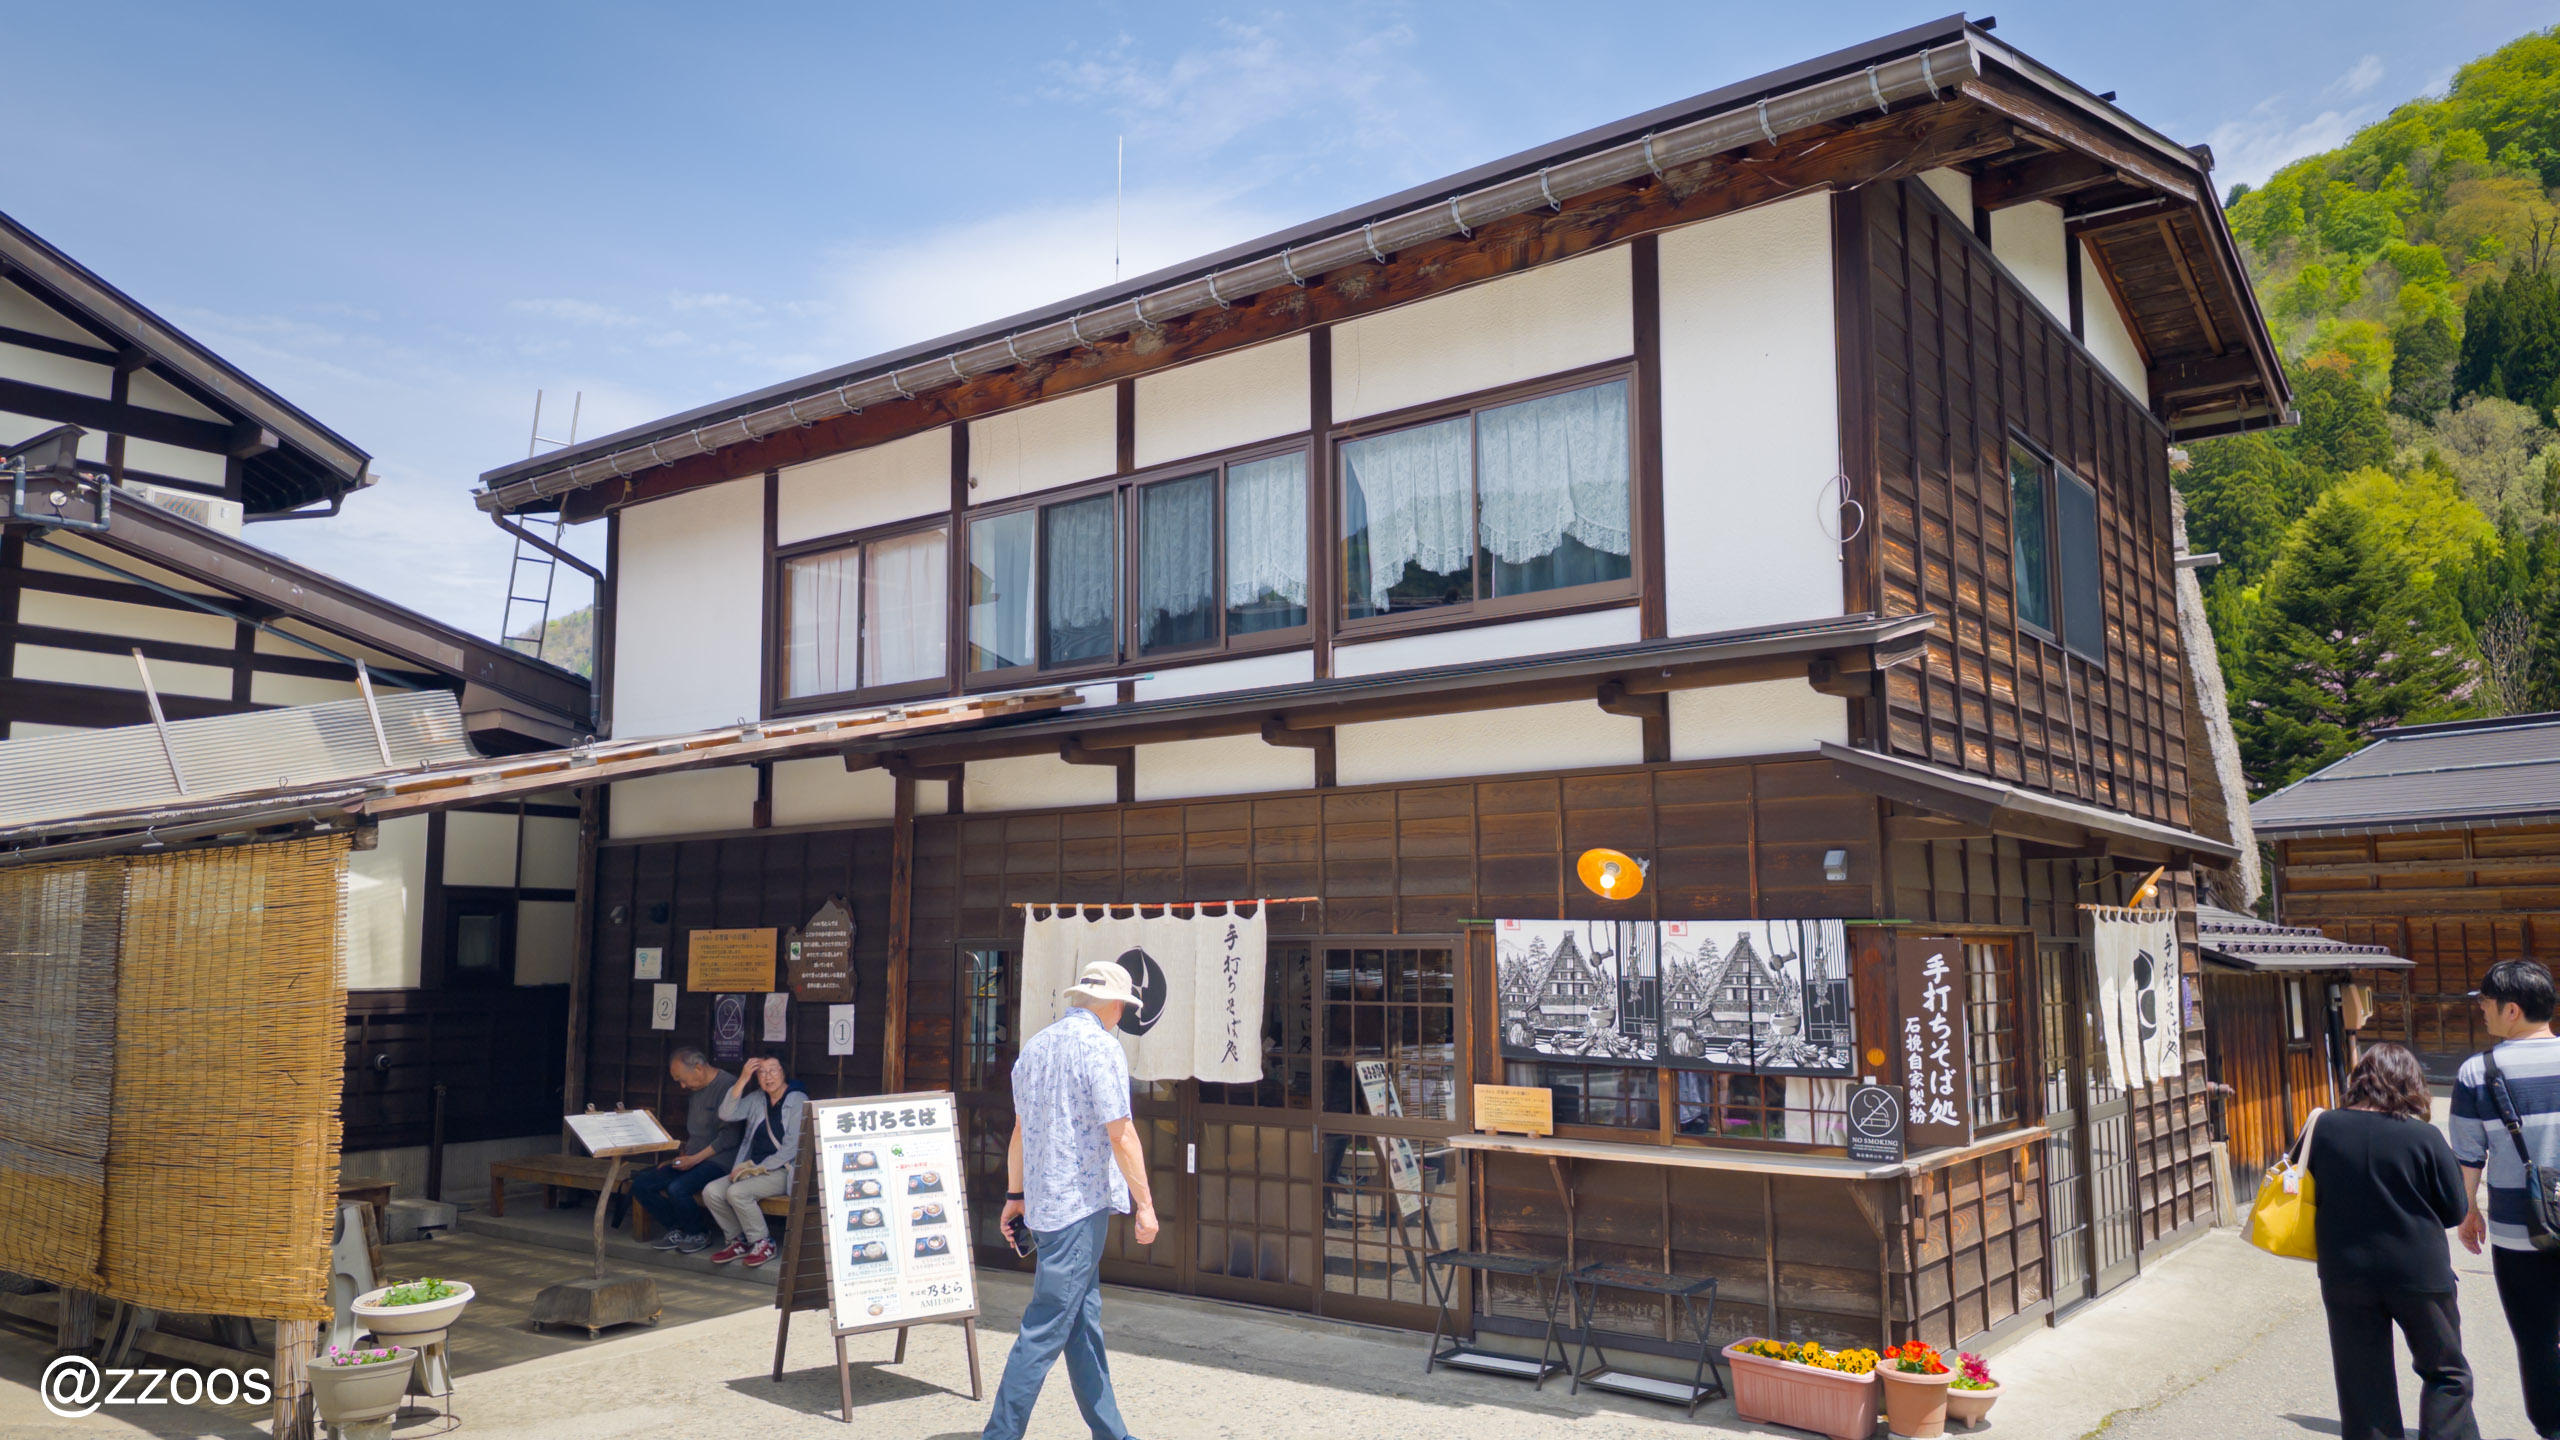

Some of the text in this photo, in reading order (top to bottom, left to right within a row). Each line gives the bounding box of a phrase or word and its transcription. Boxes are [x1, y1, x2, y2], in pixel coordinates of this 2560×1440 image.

[1221, 923, 1241, 1064] 手打ちそば処
[1922, 952, 1961, 1127] 手打ちそば処
[836, 1107, 937, 1134] 手打ちそば
[1904, 1016, 1928, 1125] 石挽自家製粉
[1851, 1136, 1899, 1147] NO SMOKING
